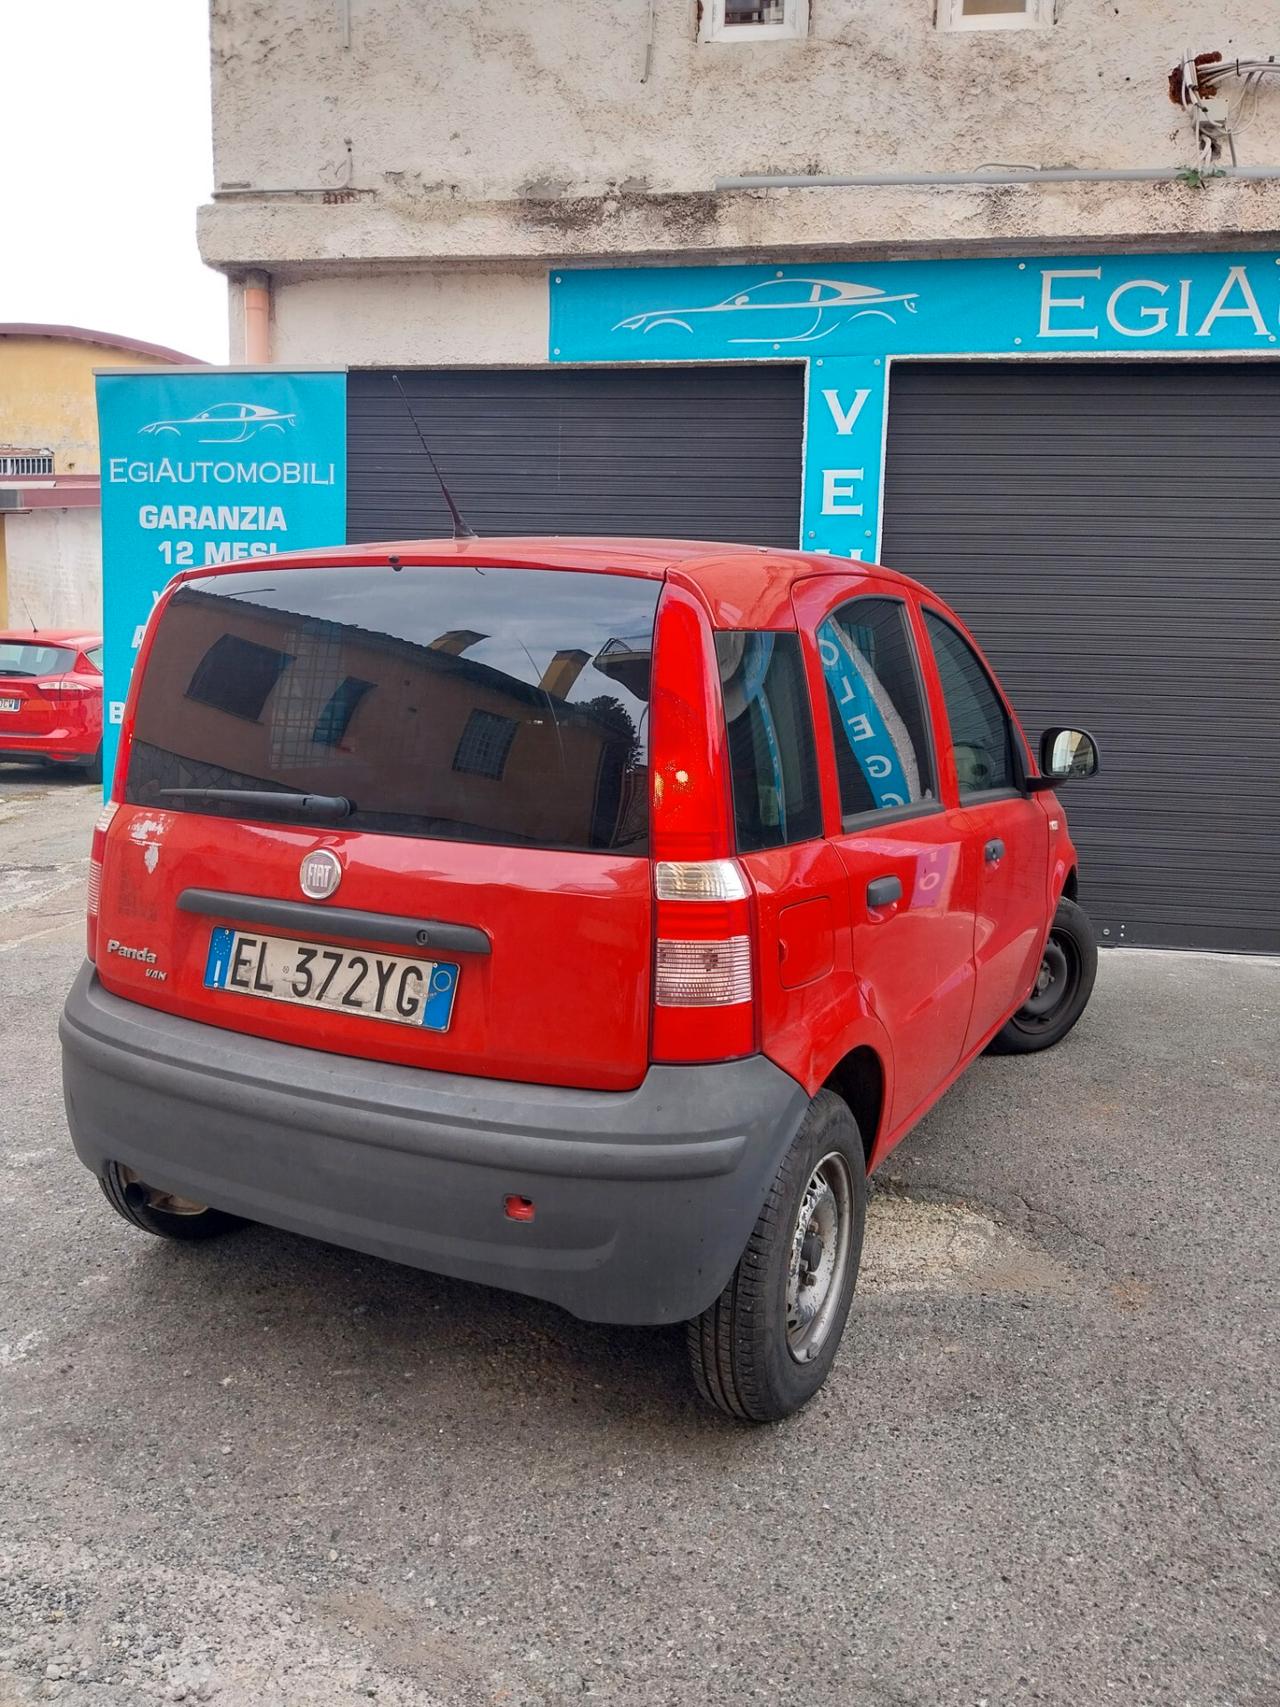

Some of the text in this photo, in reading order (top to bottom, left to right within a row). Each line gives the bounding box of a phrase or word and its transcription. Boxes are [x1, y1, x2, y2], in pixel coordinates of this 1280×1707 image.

[1036, 266, 1280, 339] EGIA
[139, 505, 287, 531] GARANZIA
[158, 541, 194, 565] 12
[307, 863, 332, 888] FIAT
[107, 939, 157, 963] Panda
[145, 968, 167, 981] VAN
[230, 937, 273, 992] EL
[291, 948, 424, 1017] 372YG
